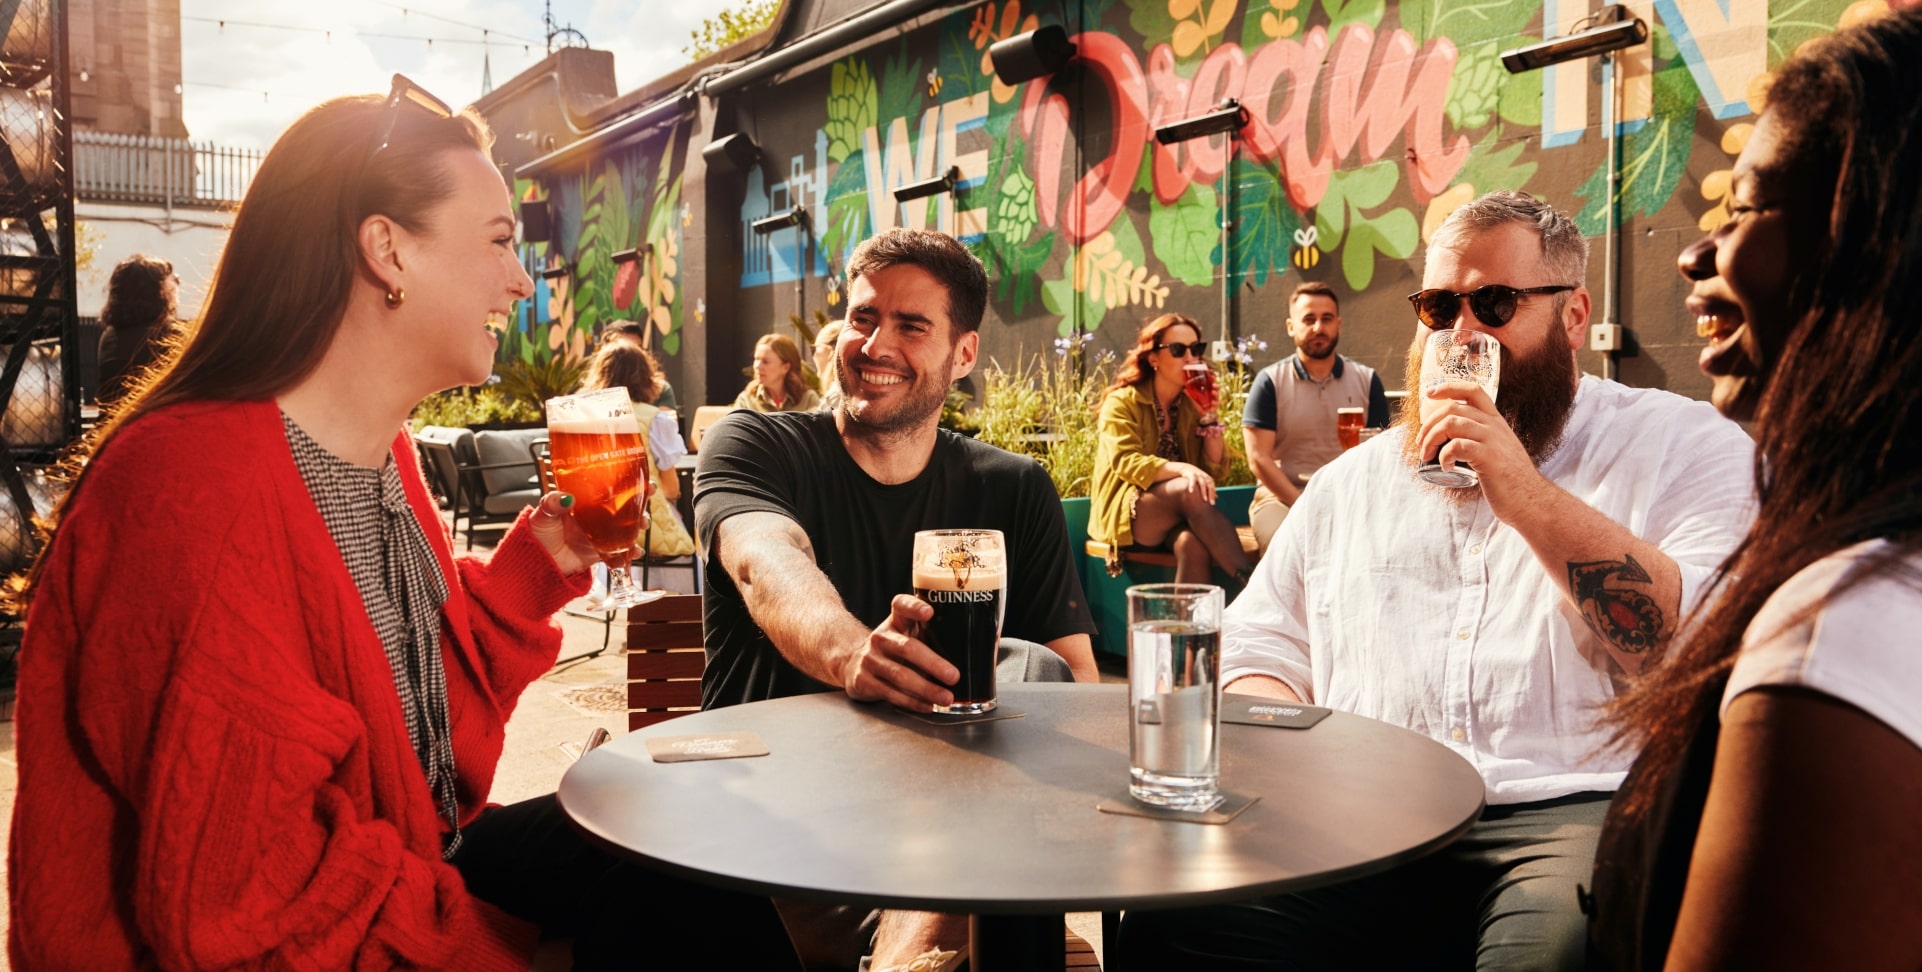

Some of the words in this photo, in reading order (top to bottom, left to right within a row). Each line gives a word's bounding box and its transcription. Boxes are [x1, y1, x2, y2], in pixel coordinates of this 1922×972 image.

[862, 90, 990, 242] WE
[1018, 22, 1470, 246] Dream
[1541, 0, 1768, 149] IN
[591, 452, 608, 462] OPEN
[610, 449, 625, 458] GATE
[928, 589, 993, 603] GUINNESS
